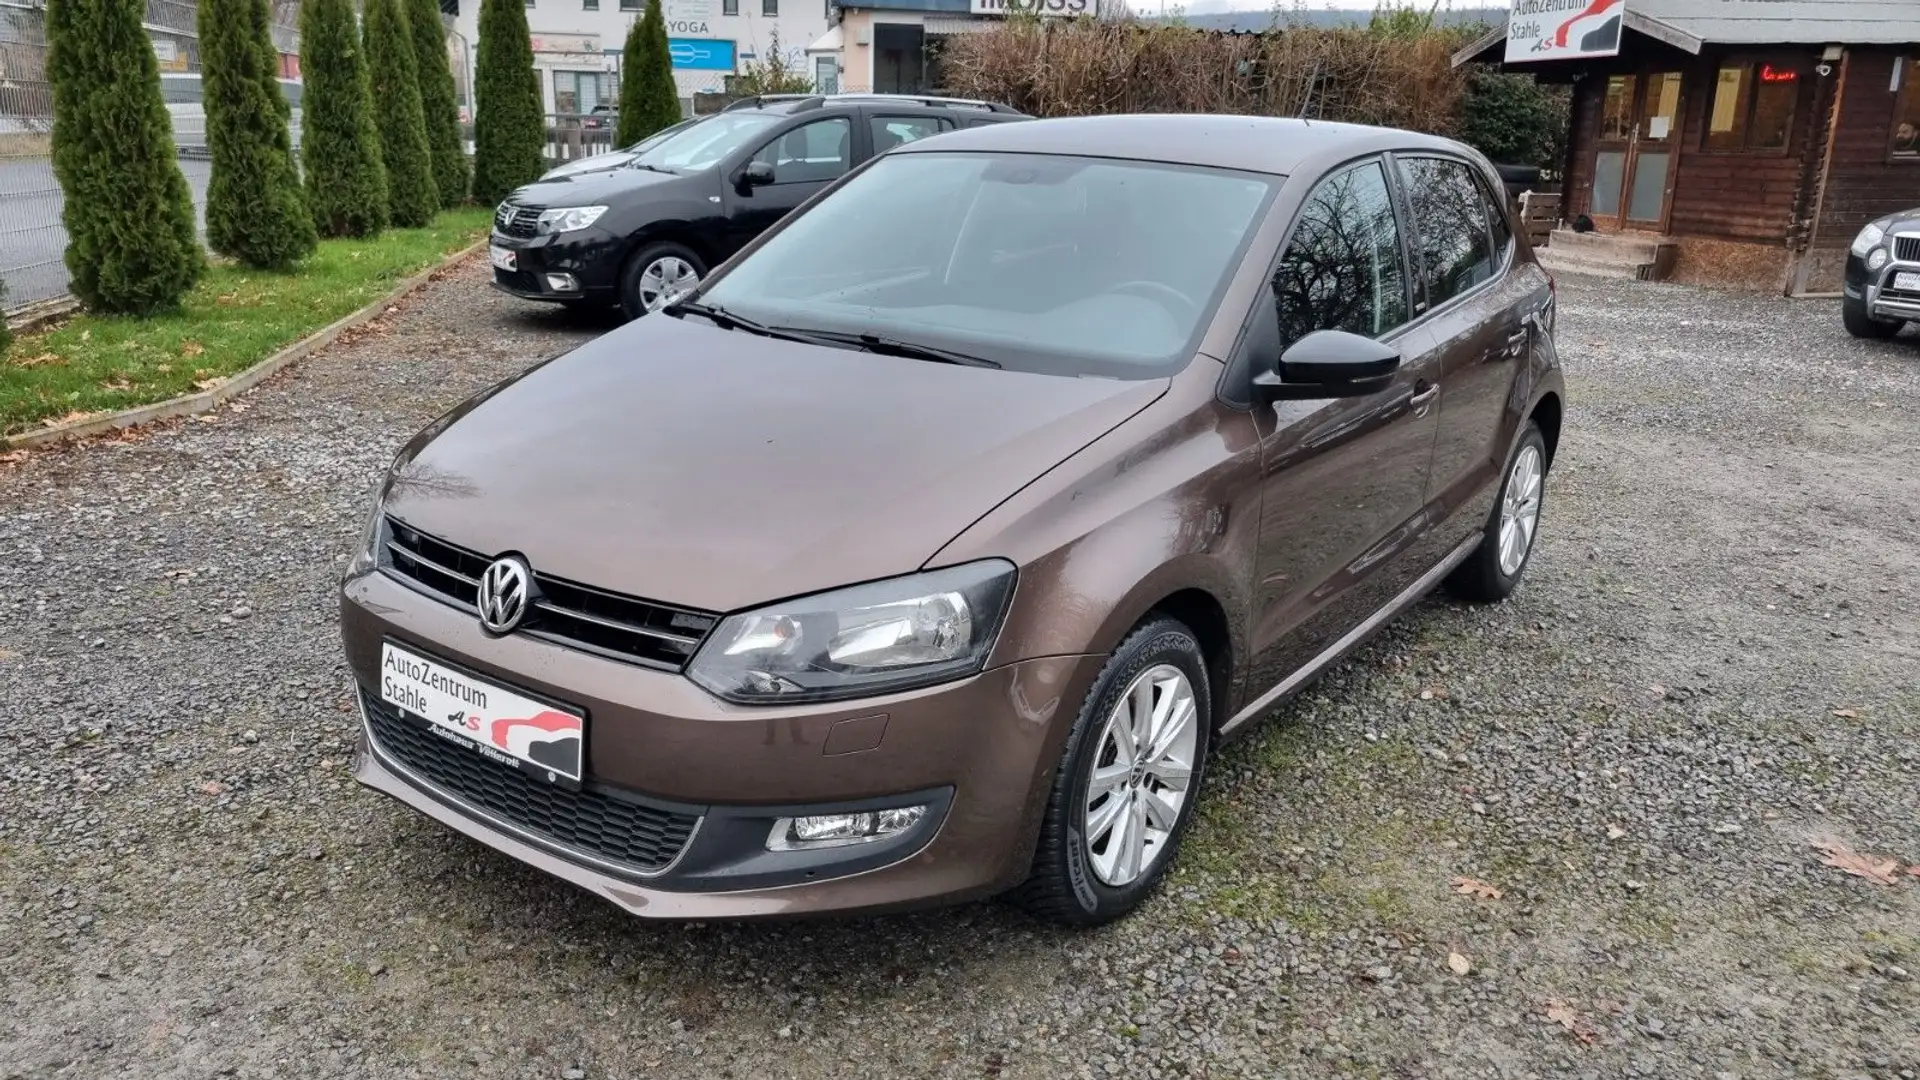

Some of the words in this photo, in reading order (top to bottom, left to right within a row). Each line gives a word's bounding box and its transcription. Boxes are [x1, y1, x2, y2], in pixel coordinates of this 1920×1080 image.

[669, 21, 709, 33] YOGA
[1510, 21, 1541, 40] Stahle
[384, 649, 488, 709] AutoZentrum
[384, 676, 428, 713] Stahle
